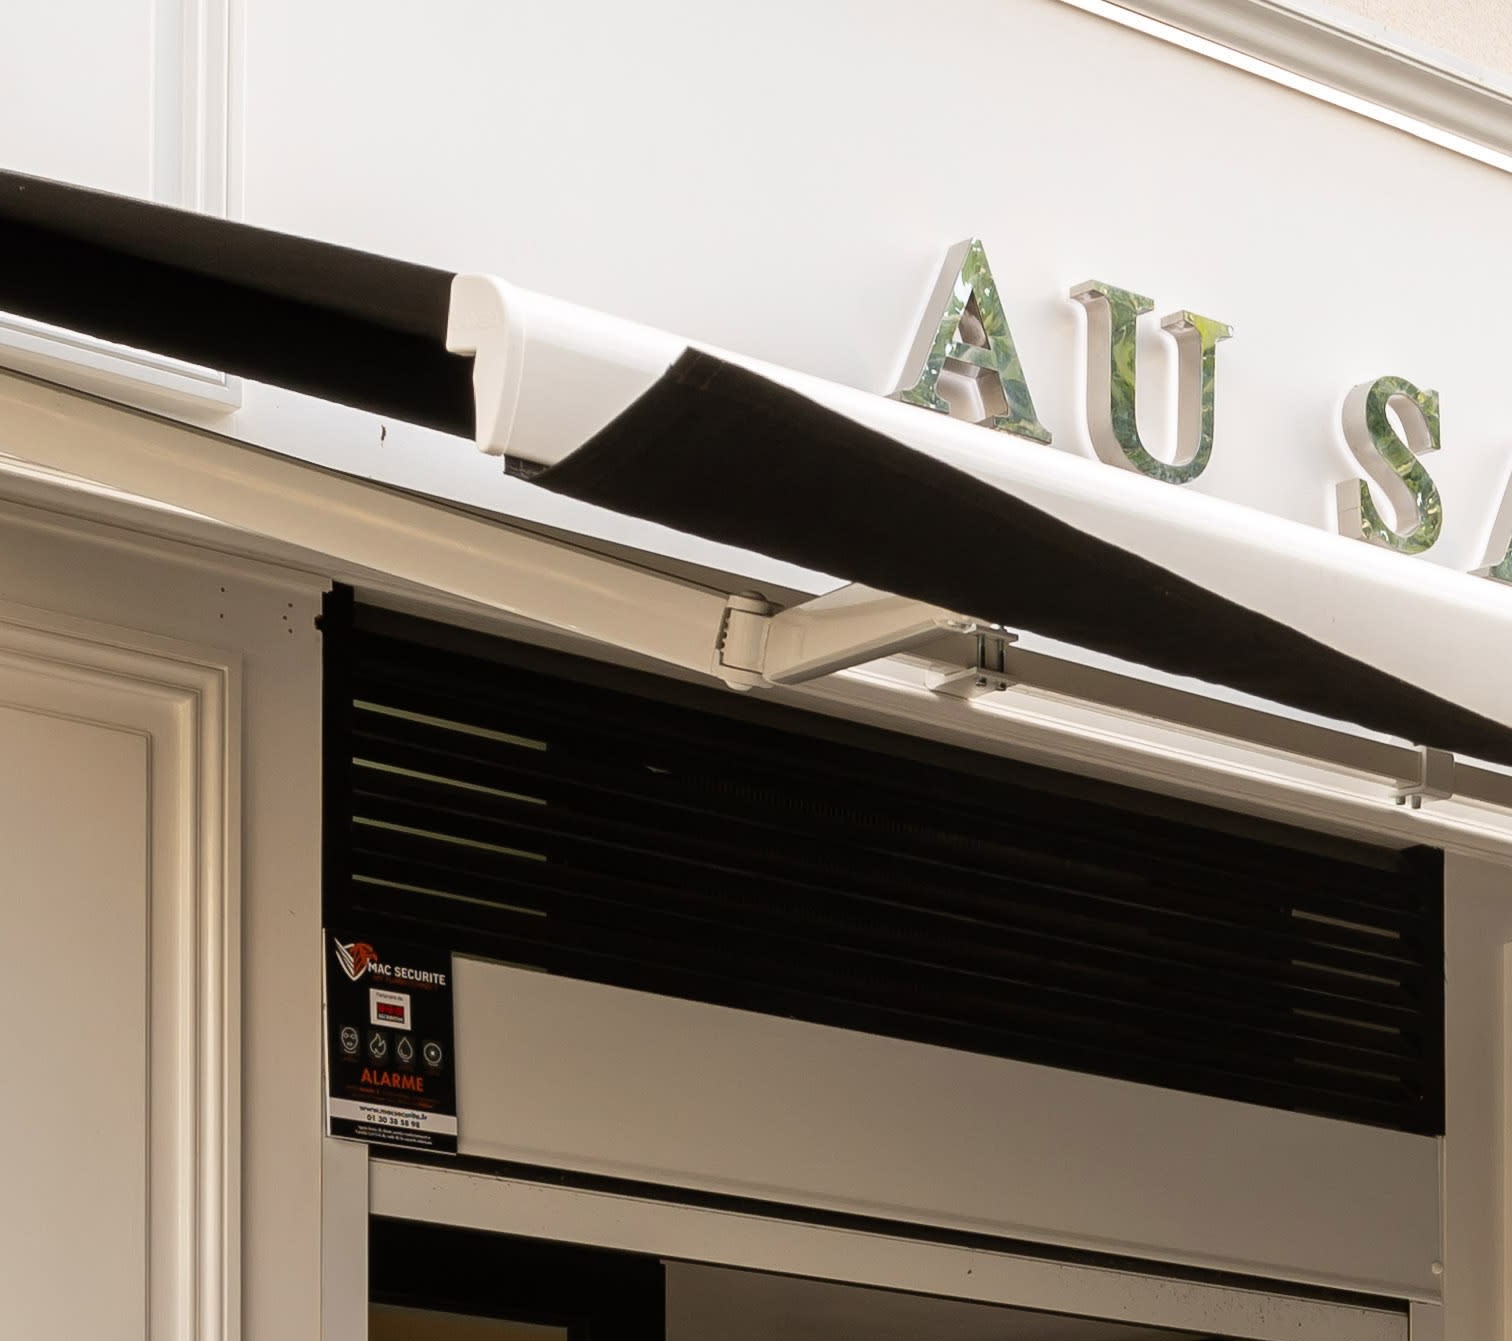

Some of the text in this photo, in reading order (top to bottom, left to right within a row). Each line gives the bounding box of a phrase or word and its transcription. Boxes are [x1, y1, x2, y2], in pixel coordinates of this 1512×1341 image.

[888, 236, 1235, 485] AU
[368, 961, 392, 976] MAC
[394, 965, 447, 986] SECURITE
[360, 1066, 425, 1093] ALARME
